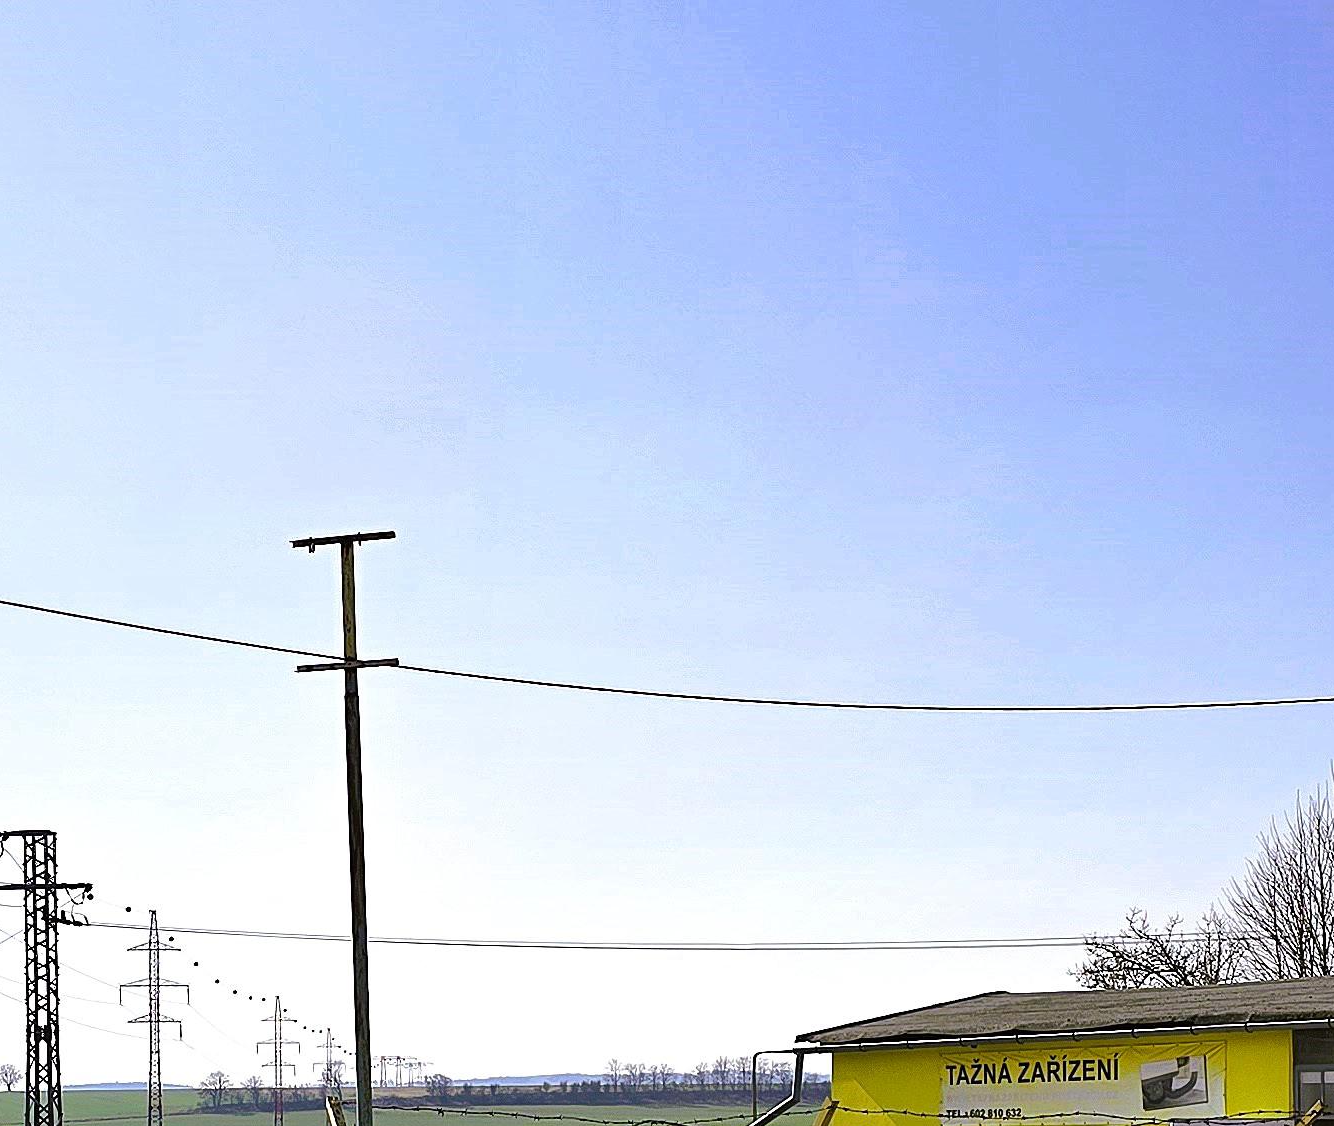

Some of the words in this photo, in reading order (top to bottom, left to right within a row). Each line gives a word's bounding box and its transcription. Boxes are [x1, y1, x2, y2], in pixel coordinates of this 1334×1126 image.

[946, 1056, 1012, 1086] TAŽNÁ
[1017, 1053, 1119, 1084] ZAŘÍZENÍ
[1005, 1108, 1022, 1118] 632
